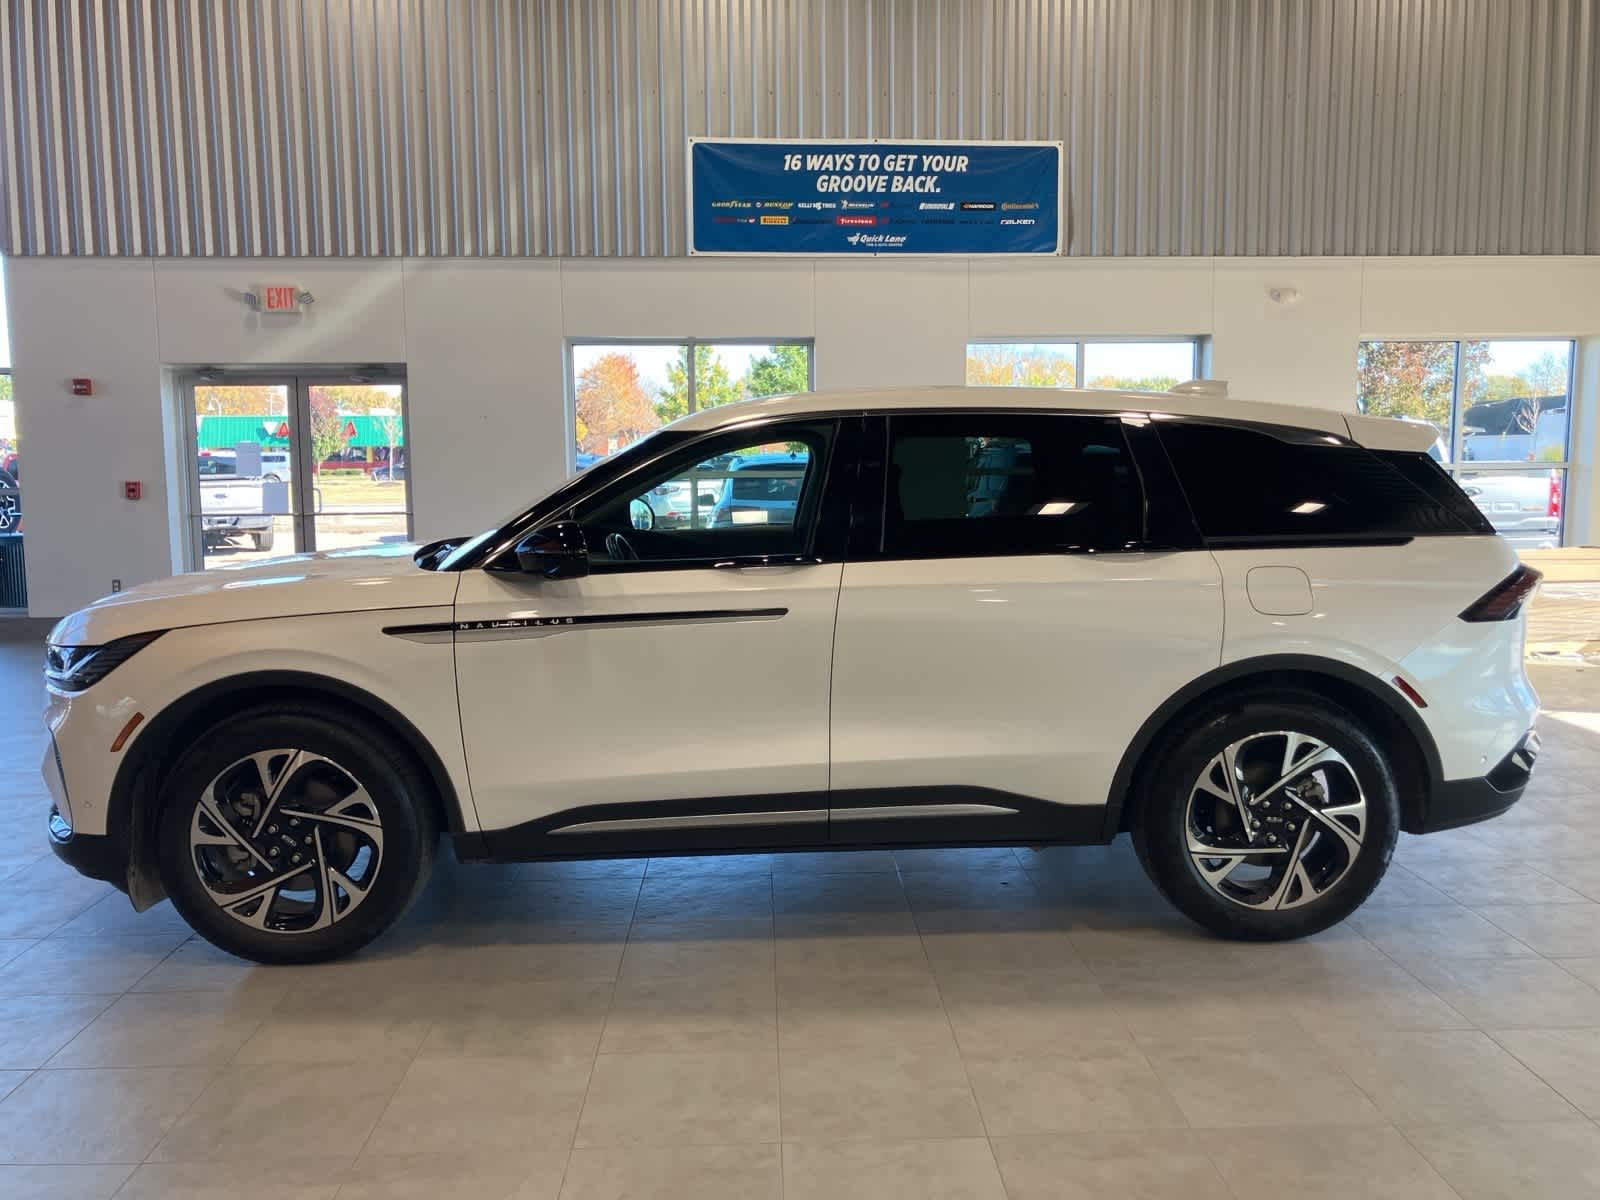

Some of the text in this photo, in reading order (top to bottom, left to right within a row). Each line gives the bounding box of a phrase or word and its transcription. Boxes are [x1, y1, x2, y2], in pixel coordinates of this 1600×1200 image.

[784, 154, 969, 173] 16 WAYS TO GET YOUR
[816, 175, 941, 193] GROOVE BACK.
[860, 234, 907, 243] Quick Lane
[267, 287, 296, 309] EXIT
[460, 617, 575, 631] NAUTILUS
